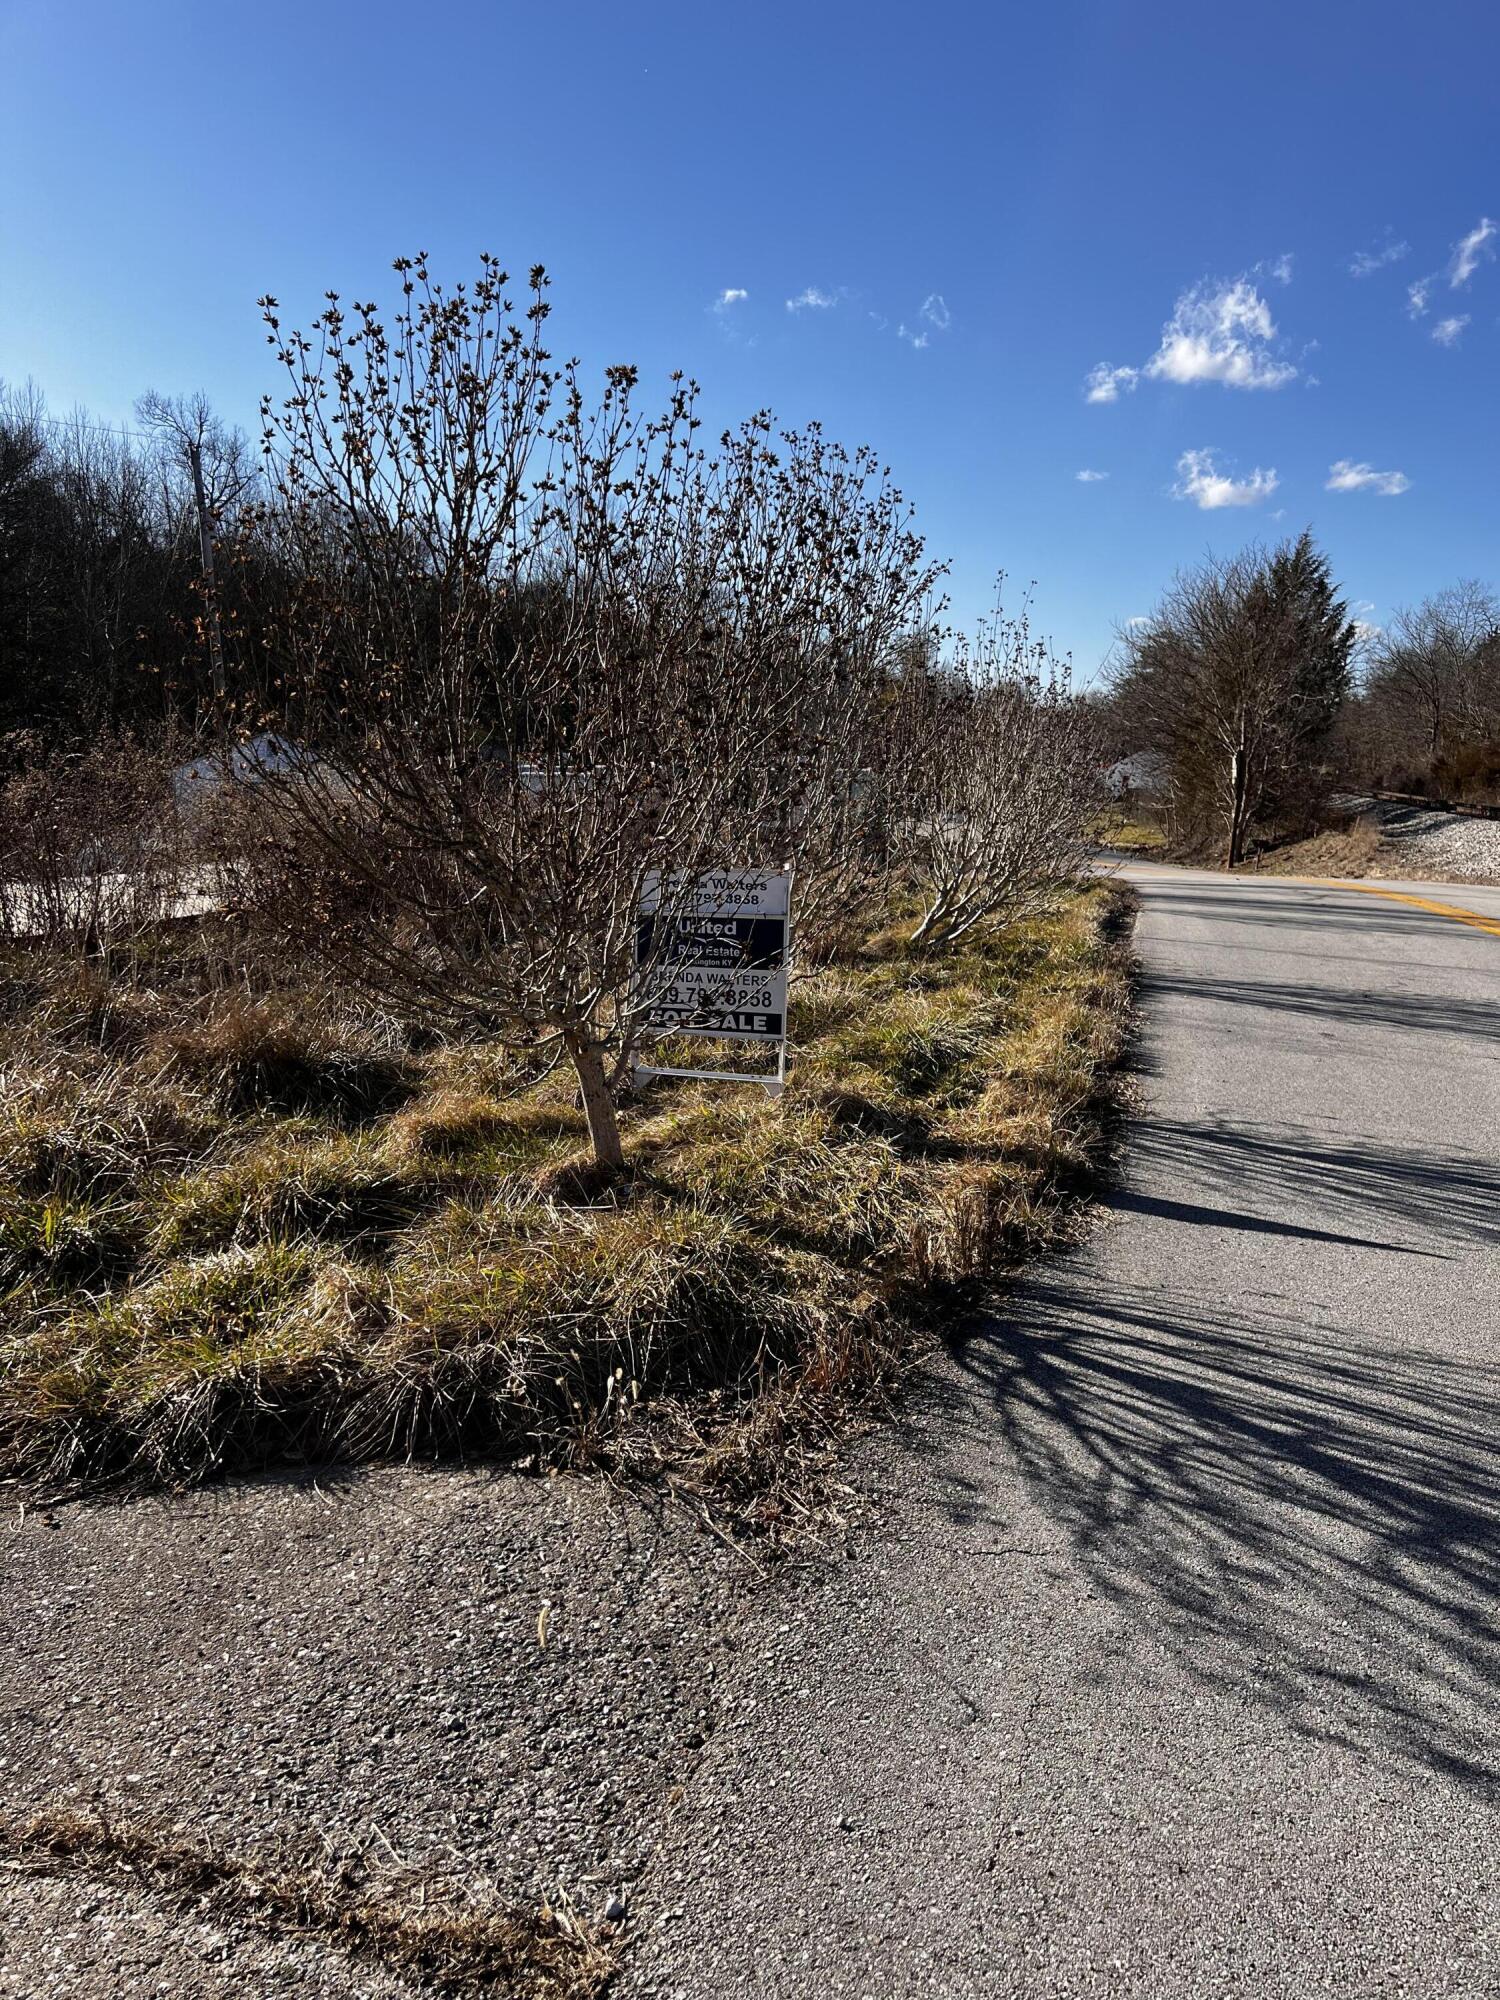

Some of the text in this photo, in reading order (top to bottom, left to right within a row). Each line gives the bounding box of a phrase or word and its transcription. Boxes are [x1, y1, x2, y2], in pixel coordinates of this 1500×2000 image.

[680, 920, 736, 935] United
[678, 944, 740, 957] Real Estate
[685, 958, 720, 966] Lington
